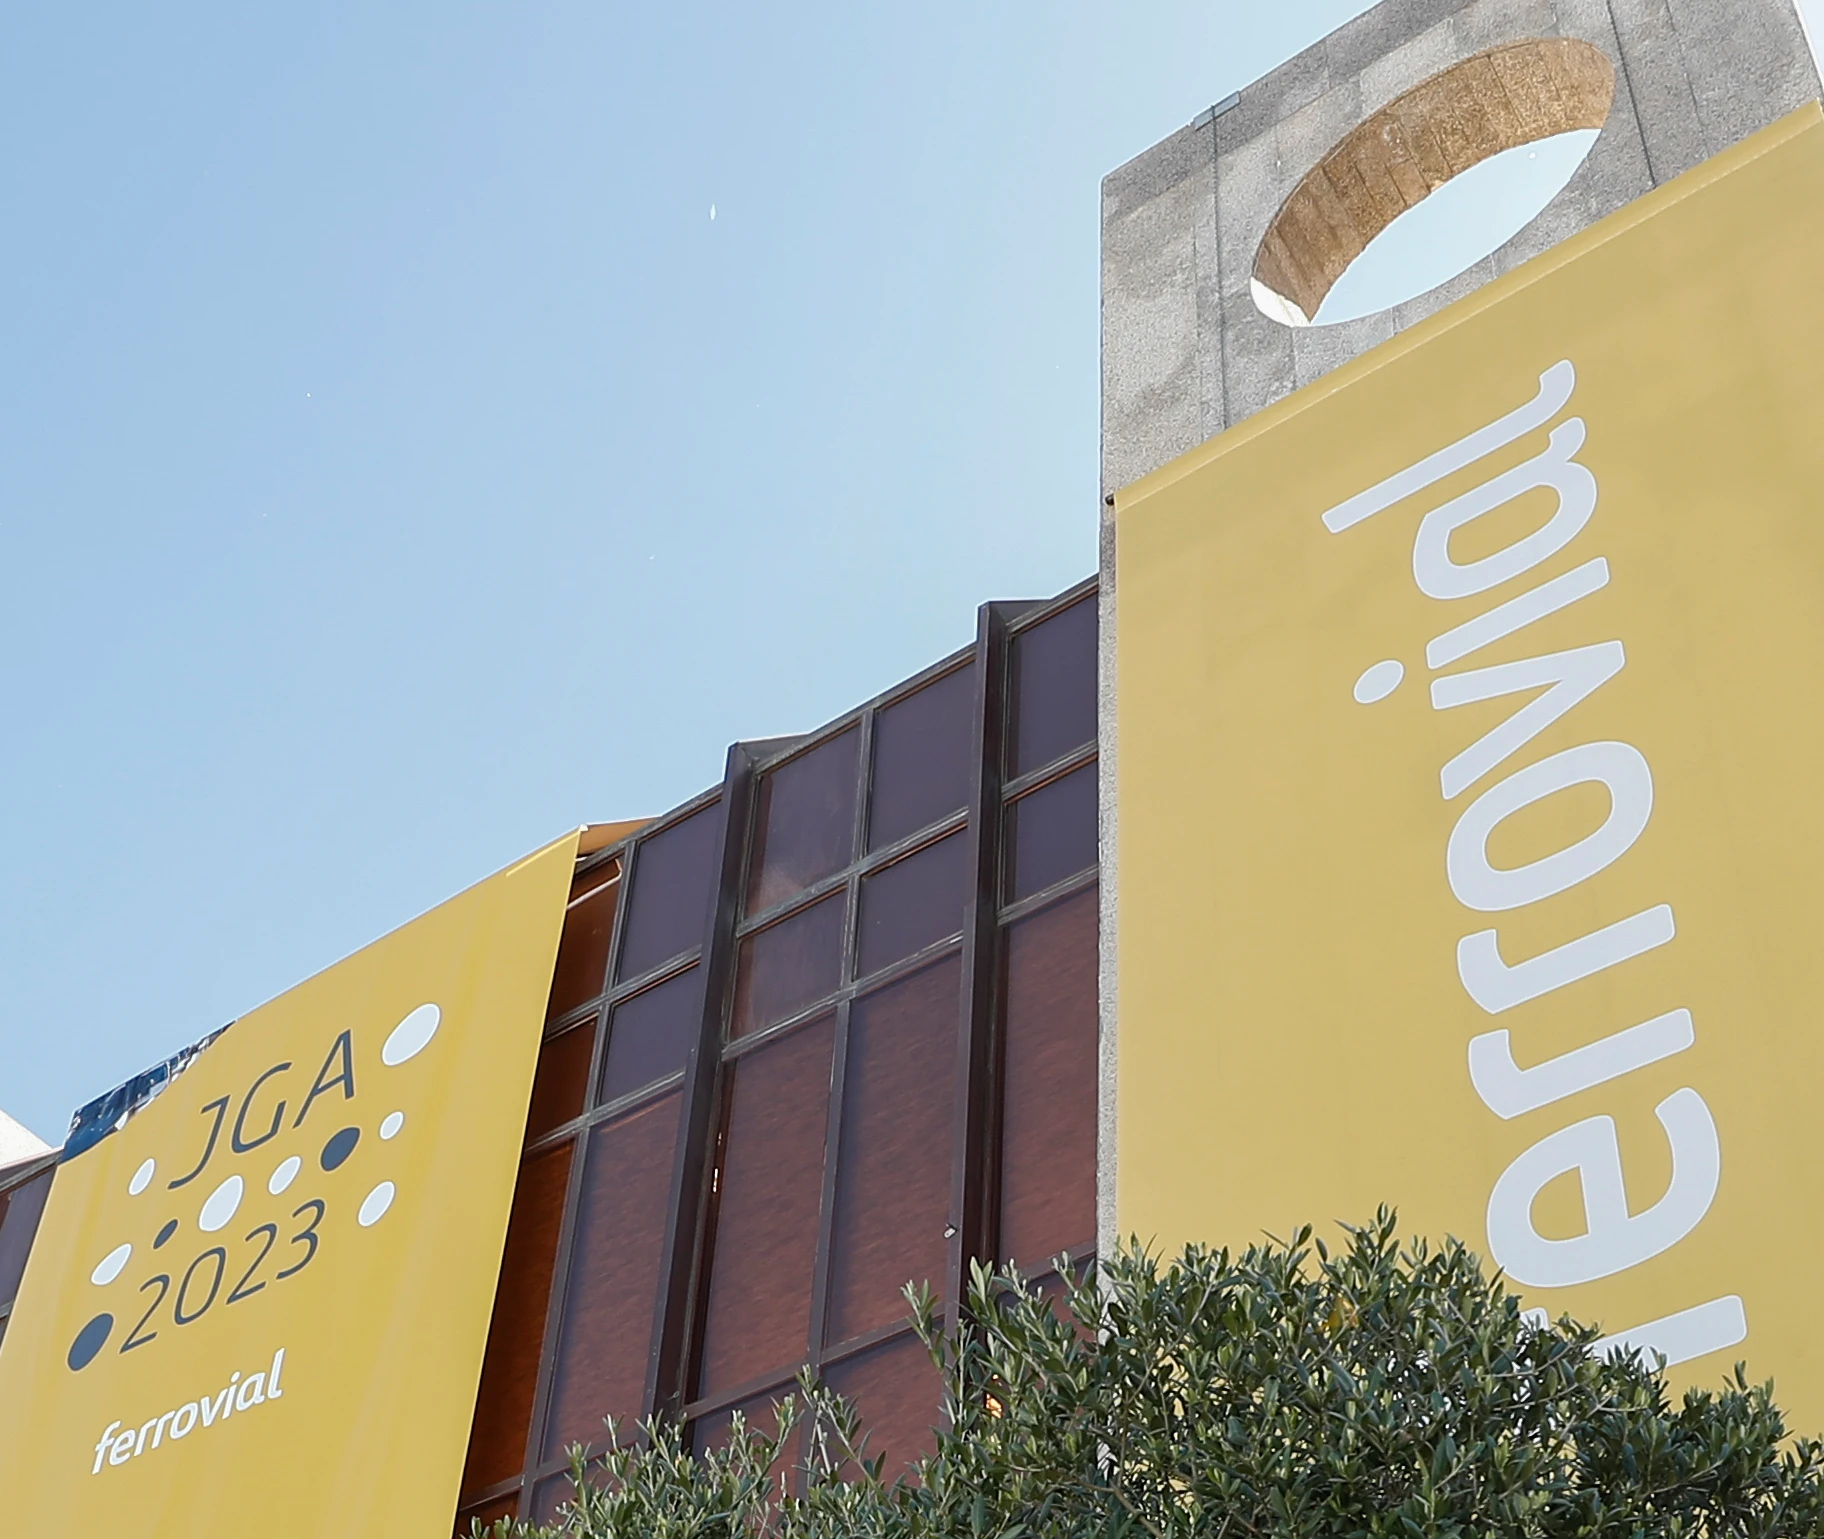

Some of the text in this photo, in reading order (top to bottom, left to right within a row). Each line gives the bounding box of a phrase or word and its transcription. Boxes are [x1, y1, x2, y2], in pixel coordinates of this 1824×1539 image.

[168, 1028, 355, 1190] JGA
[119, 1198, 326, 1354] 2023
[91, 1347, 286, 1475] ferrovial
